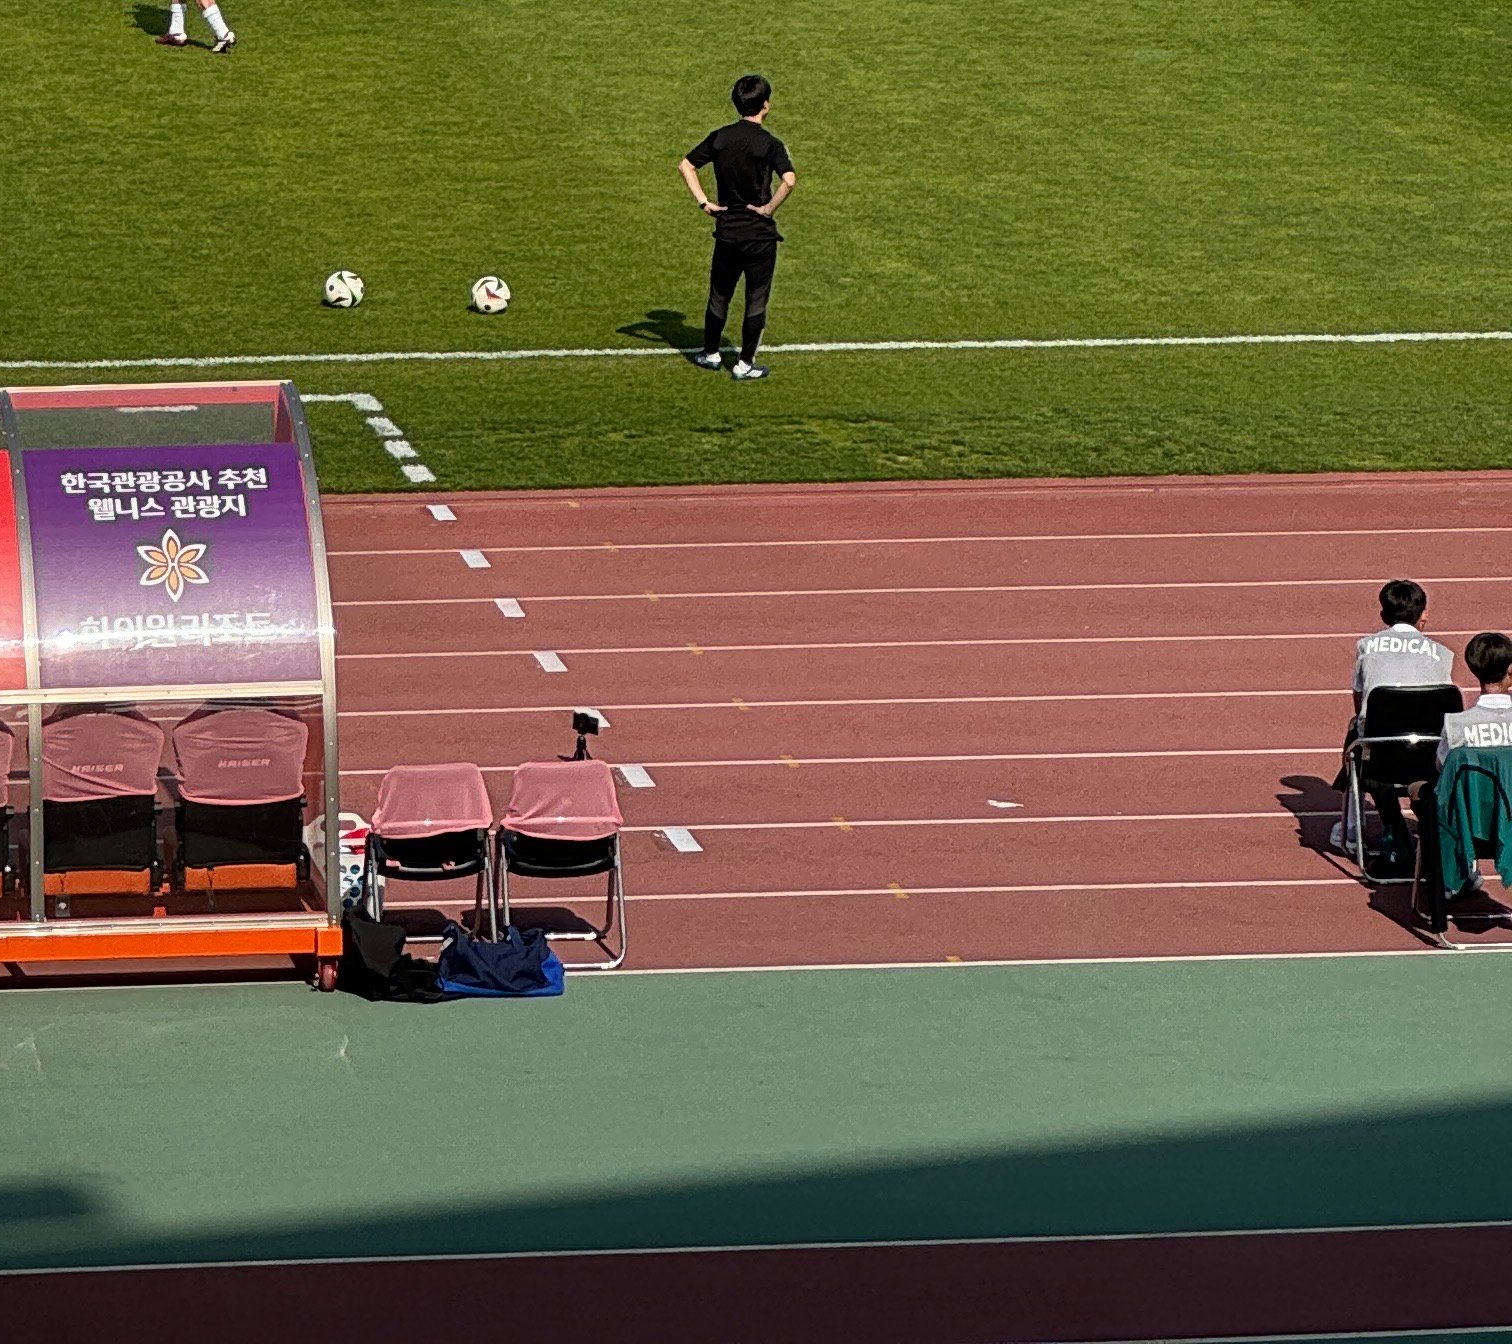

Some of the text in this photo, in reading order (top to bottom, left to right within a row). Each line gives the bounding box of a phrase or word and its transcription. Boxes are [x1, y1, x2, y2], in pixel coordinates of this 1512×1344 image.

[60, 467, 268, 493] 한국관광공사 추천
[88, 493, 247, 521] 웰니스 관광지
[1366, 636, 1441, 662] MEDICAL
